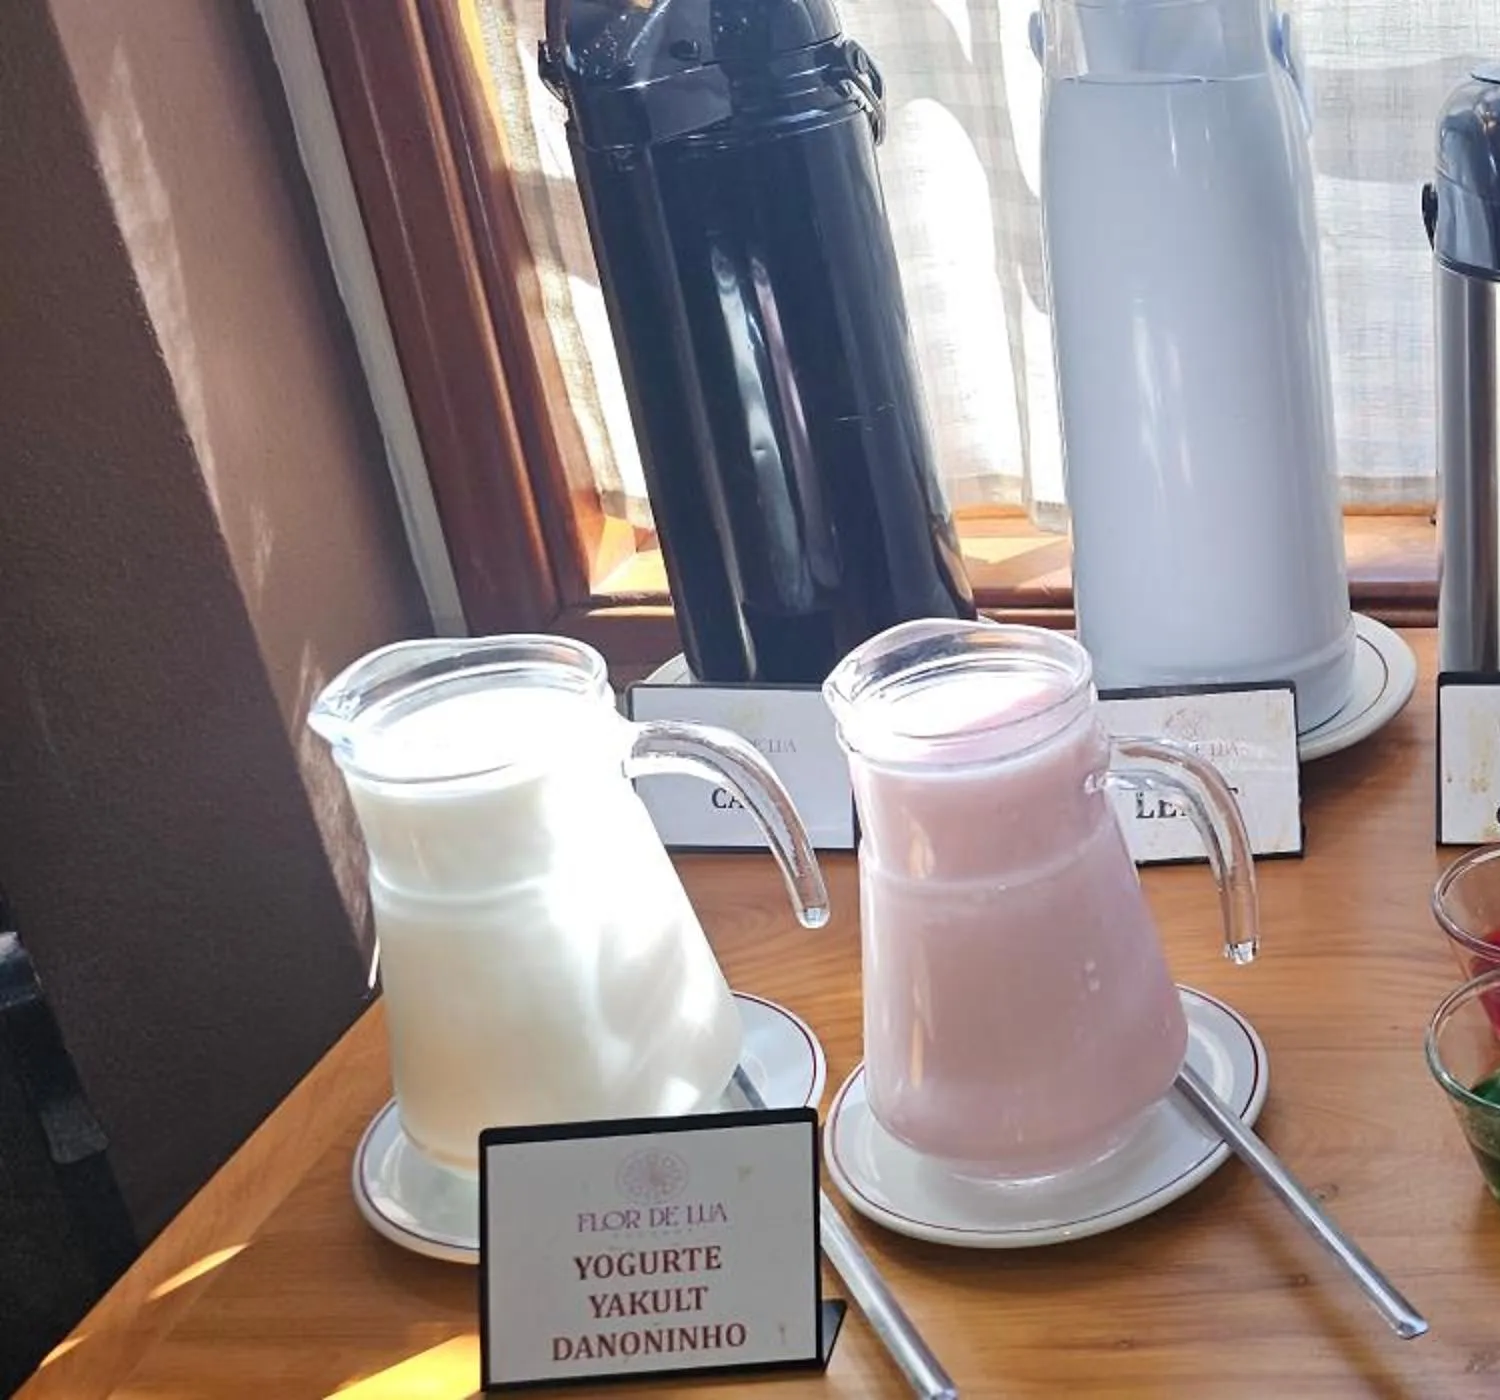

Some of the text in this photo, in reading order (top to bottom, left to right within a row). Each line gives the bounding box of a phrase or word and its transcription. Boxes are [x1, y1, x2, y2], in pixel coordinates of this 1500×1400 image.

[577, 1202, 728, 1232] FLOR DE LUA
[573, 1245, 722, 1281] YOGURTE
[588, 1286, 709, 1318] YAKULT
[552, 1322, 747, 1361] DANONINHO
